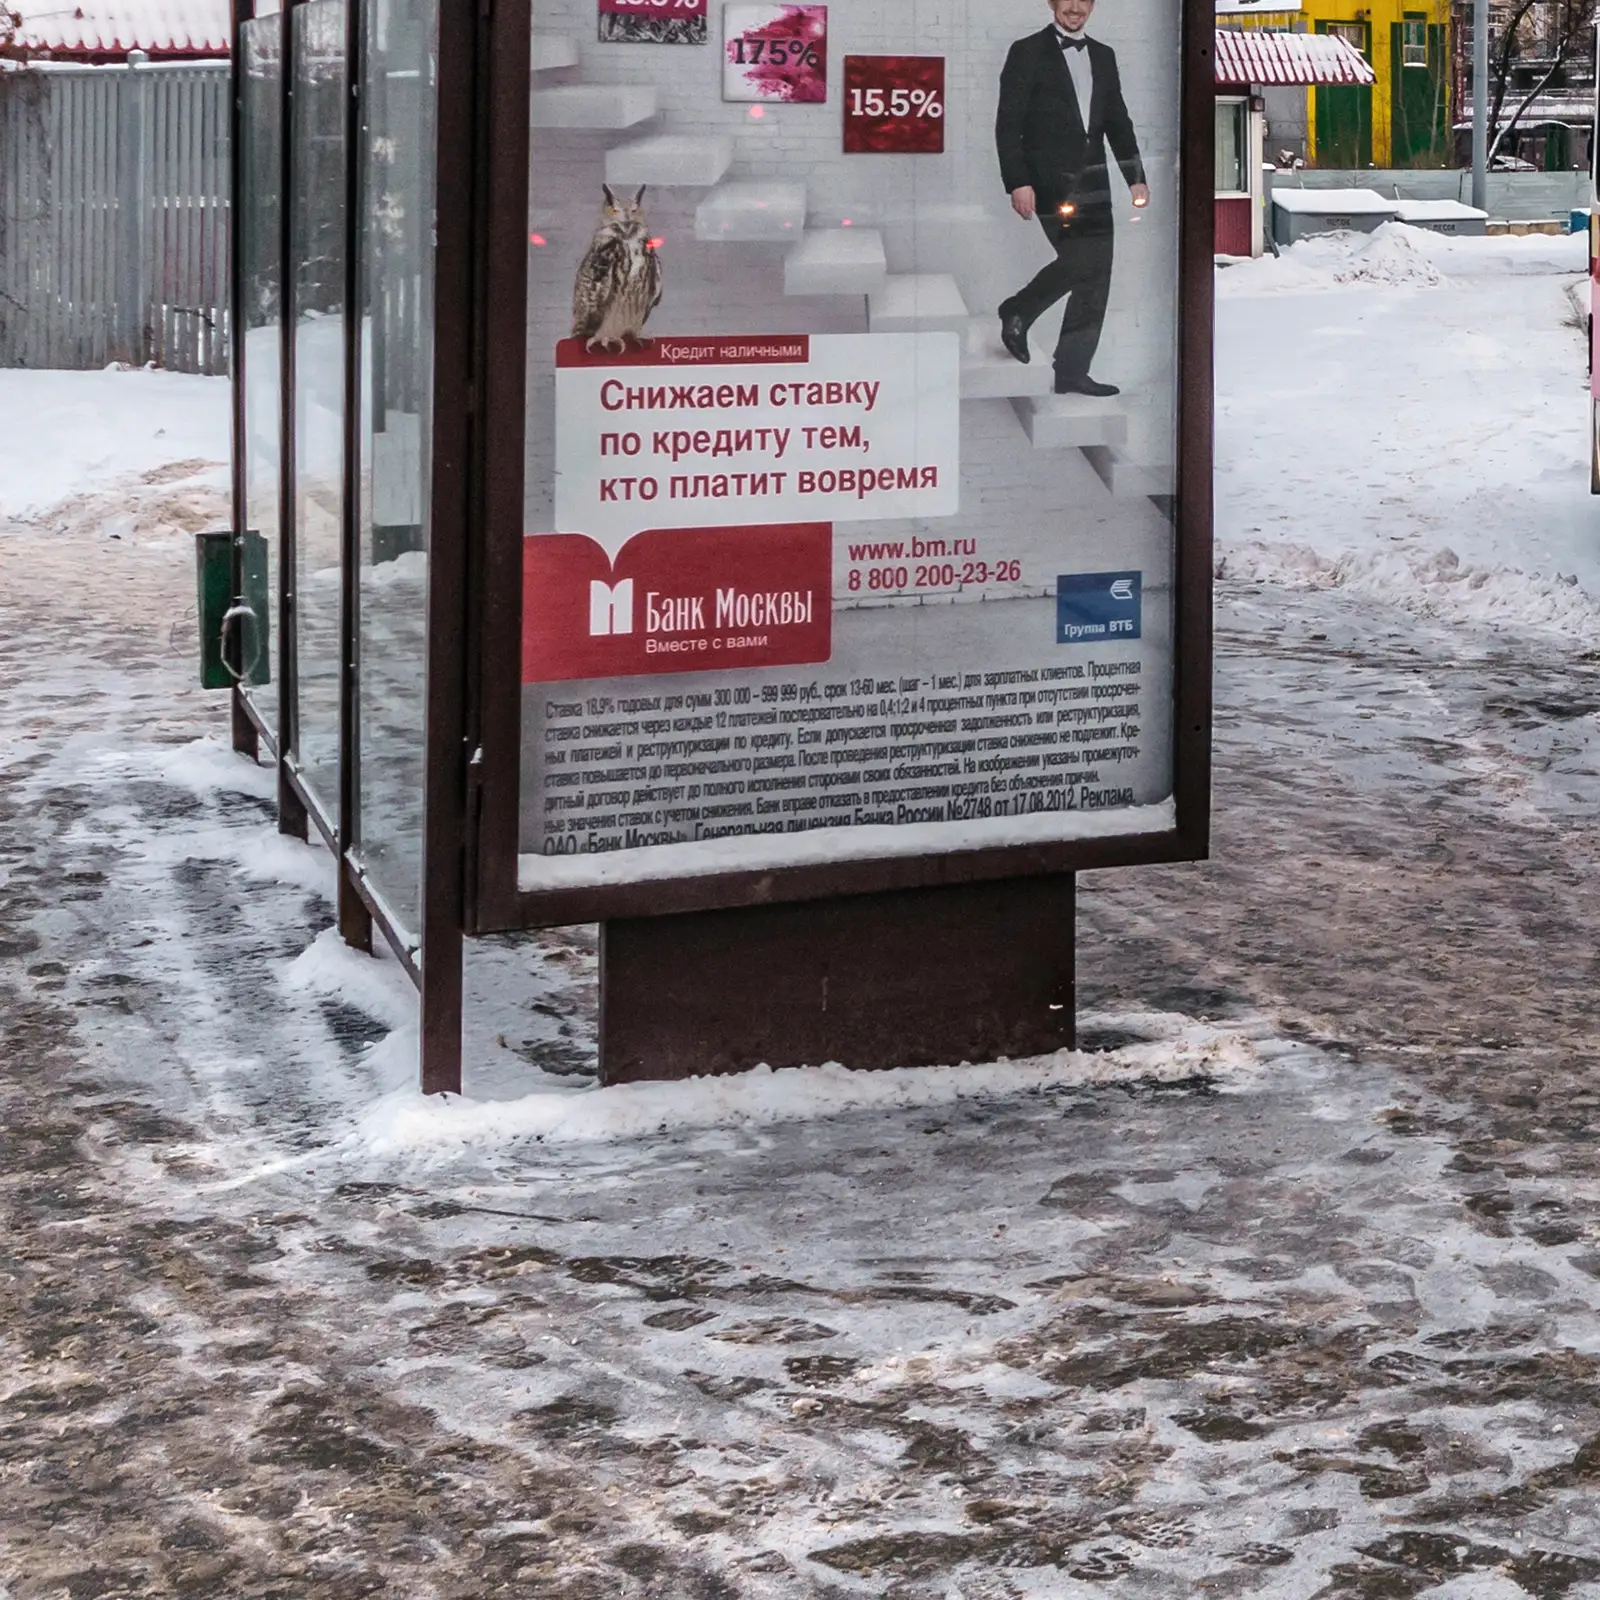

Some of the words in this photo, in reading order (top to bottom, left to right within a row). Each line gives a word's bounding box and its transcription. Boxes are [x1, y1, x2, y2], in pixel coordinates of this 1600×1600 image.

[733, 38, 821, 68] 17.5%
[850, 89, 943, 118] 15.5%
[661, 343, 715, 361] Кредит
[719, 343, 802, 358] наличными
[600, 379, 759, 411] Снижаем
[769, 380, 880, 410] ставку
[600, 432, 641, 456] по
[653, 427, 791, 461] кредиту
[801, 425, 870, 453] тем,
[600, 476, 658, 501] кто
[670, 471, 787, 500] платит
[798, 465, 938, 499] вовремя
[848, 535, 976, 561] www.bm.ru
[848, 569, 861, 591] 8
[868, 566, 908, 589] 800
[915, 560, 1021, 587] 200-23-26
[646, 591, 705, 633] Банк
[716, 587, 813, 629] Москвы
[1064, 623, 1106, 637] Группа
[1109, 619, 1133, 632] ВТБ
[646, 637, 708, 653] Вместе
[712, 639, 722, 649] с
[727, 636, 768, 649] вами
[545, 702, 581, 718] Ставка
[617, 697, 660, 714] годовых
[664, 695, 682, 711] для
[685, 693, 711, 710] сумм
[714, 688, 731, 706] 300
[734, 686, 750, 705] 000
[800, 681, 821, 702] руб.,
[824, 683, 846, 700] срок
[850, 678, 873, 695] 13-60
[876, 679, 896, 693] мес.
[899, 675, 920, 695] (шаг
[932, 674, 935, 689] 1
[939, 672, 961, 690] мес.)
[964, 673, 980, 689] для
[984, 669, 1038, 687] зарплатных
[1040, 665, 1084, 681] клиентов.
[1088, 661, 1140, 680] Процентная
[545, 726, 580, 741] ставка
[583, 721, 638, 738] снижается
[641, 719, 670, 737] через
[673, 716, 712, 733] каждые
[716, 711, 726, 728] 12
[728, 707, 776, 727] платежей
[779, 704, 864, 724] последовательно
[867, 704, 877, 716] на
[911, 700, 916, 712] и
[919, 697, 924, 712] 4
[927, 695, 983, 714] процентных
[985, 692, 1016, 710] пункта
[1019, 690, 1035, 707] при
[1038, 686, 1088, 705] отсутствии
[1091, 682, 1140, 700] просрочен-
[545, 750, 565, 763] ных
[571, 742, 621, 761] платежей
[627, 744, 632, 757] и
[637, 738, 729, 760] реструктуризации
[734, 736, 746, 749] по
[751, 733, 793, 751] кредиту.
[797, 727, 821, 744] Если
[825, 724, 885, 745] допускается
[890, 719, 956, 740] просроченная
[961, 713, 1032, 732] задолженность
[1036, 711, 1052, 723] или
[545, 772, 579, 787] ставка
[582, 767, 645, 784] повышается
[648, 766, 661, 780] до
[664, 758, 751, 781] первоначального
[753, 754, 795, 773] размера.
[798, 750, 827, 766] После
[830, 746, 887, 766] проведения
[889, 739, 975, 762] реструктуризации
[977, 737, 1007, 750] ставка
[1010, 731, 1056, 746] снижению
[1060, 731, 1070, 742] не
[1072, 726, 1118, 743] подлежит.
[1121, 723, 1139, 741] Кре-
[545, 790, 583, 812] дитный
[587, 791, 629, 809] договор
[632, 784, 685, 805] действует
[687, 784, 700, 800] до
[703, 781, 744, 796] полного
[747, 775, 805, 792] исполнения
[808, 770, 860, 789] сторонами
[863, 768, 889, 782] своих
[893, 759, 960, 780] обязанностей.
[964, 757, 975, 772] На
[978, 754, 1039, 773] изображении
[1042, 751, 1079, 769] указаны
[1082, 746, 1139, 765] промежуточ-
[544, 819, 564, 833] ные
[567, 815, 615, 831] значения
[617, 811, 652, 826] ставок
[655, 810, 661, 822] с
[664, 806, 699, 826] учетом
[701, 801, 753, 818] снижения.
[756, 797, 780, 813] Банк
[782, 796, 816, 814] вправе
[819, 792, 861, 808] отказать
[864, 791, 869, 804] в
[872, 784, 948, 805] предоставлении
[951, 780, 988, 797] кредита
[990, 777, 1006, 792] без
[1009, 774, 1062, 790] объяснения
[1065, 770, 1099, 787] причин.
[543, 836, 576, 855] ОАО
[580, 833, 621, 852] «Банк
[625, 828, 686, 847] Москвы»
[854, 807, 892, 825] Банка
[897, 803, 943, 823] России
[948, 796, 990, 820] №2748
[995, 799, 1009, 816] от
[1013, 790, 1077, 814] 17.08.2012.
[1080, 786, 1135, 807] Реклама.
